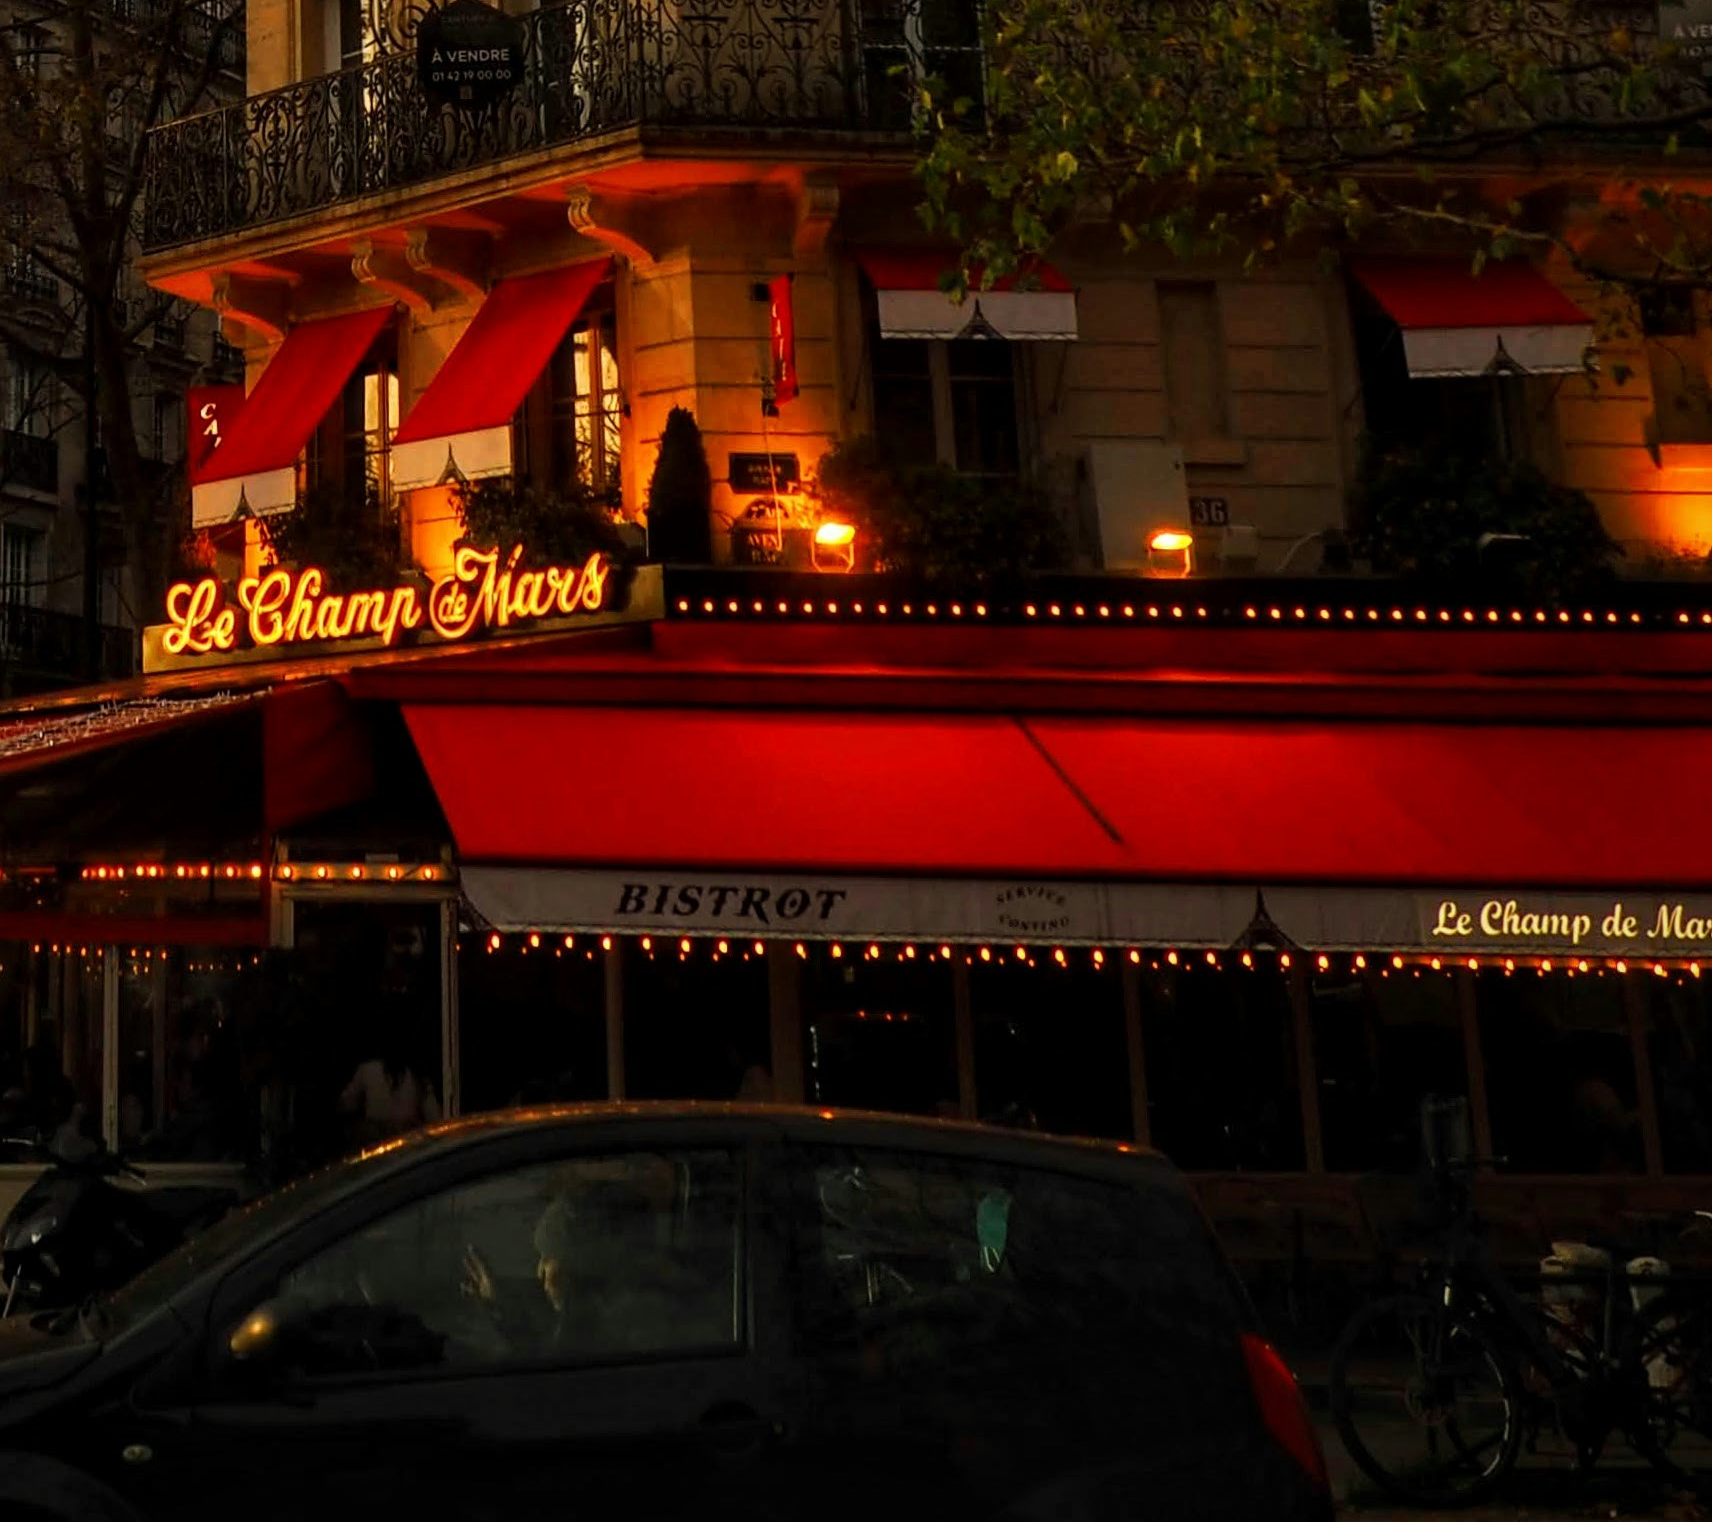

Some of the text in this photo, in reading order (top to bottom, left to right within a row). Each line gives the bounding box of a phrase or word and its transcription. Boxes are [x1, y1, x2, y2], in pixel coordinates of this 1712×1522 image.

[431, 47, 511, 64] À VENDRE
[1195, 500, 1226, 523] 36
[162, 543, 609, 654] Le Champ de Mars
[616, 883, 847, 925] BISTROT
[996, 885, 1066, 908] SERVICE
[1432, 900, 1473, 936] Le
[1480, 899, 1592, 946] Champ
[1601, 902, 1638, 938] de
